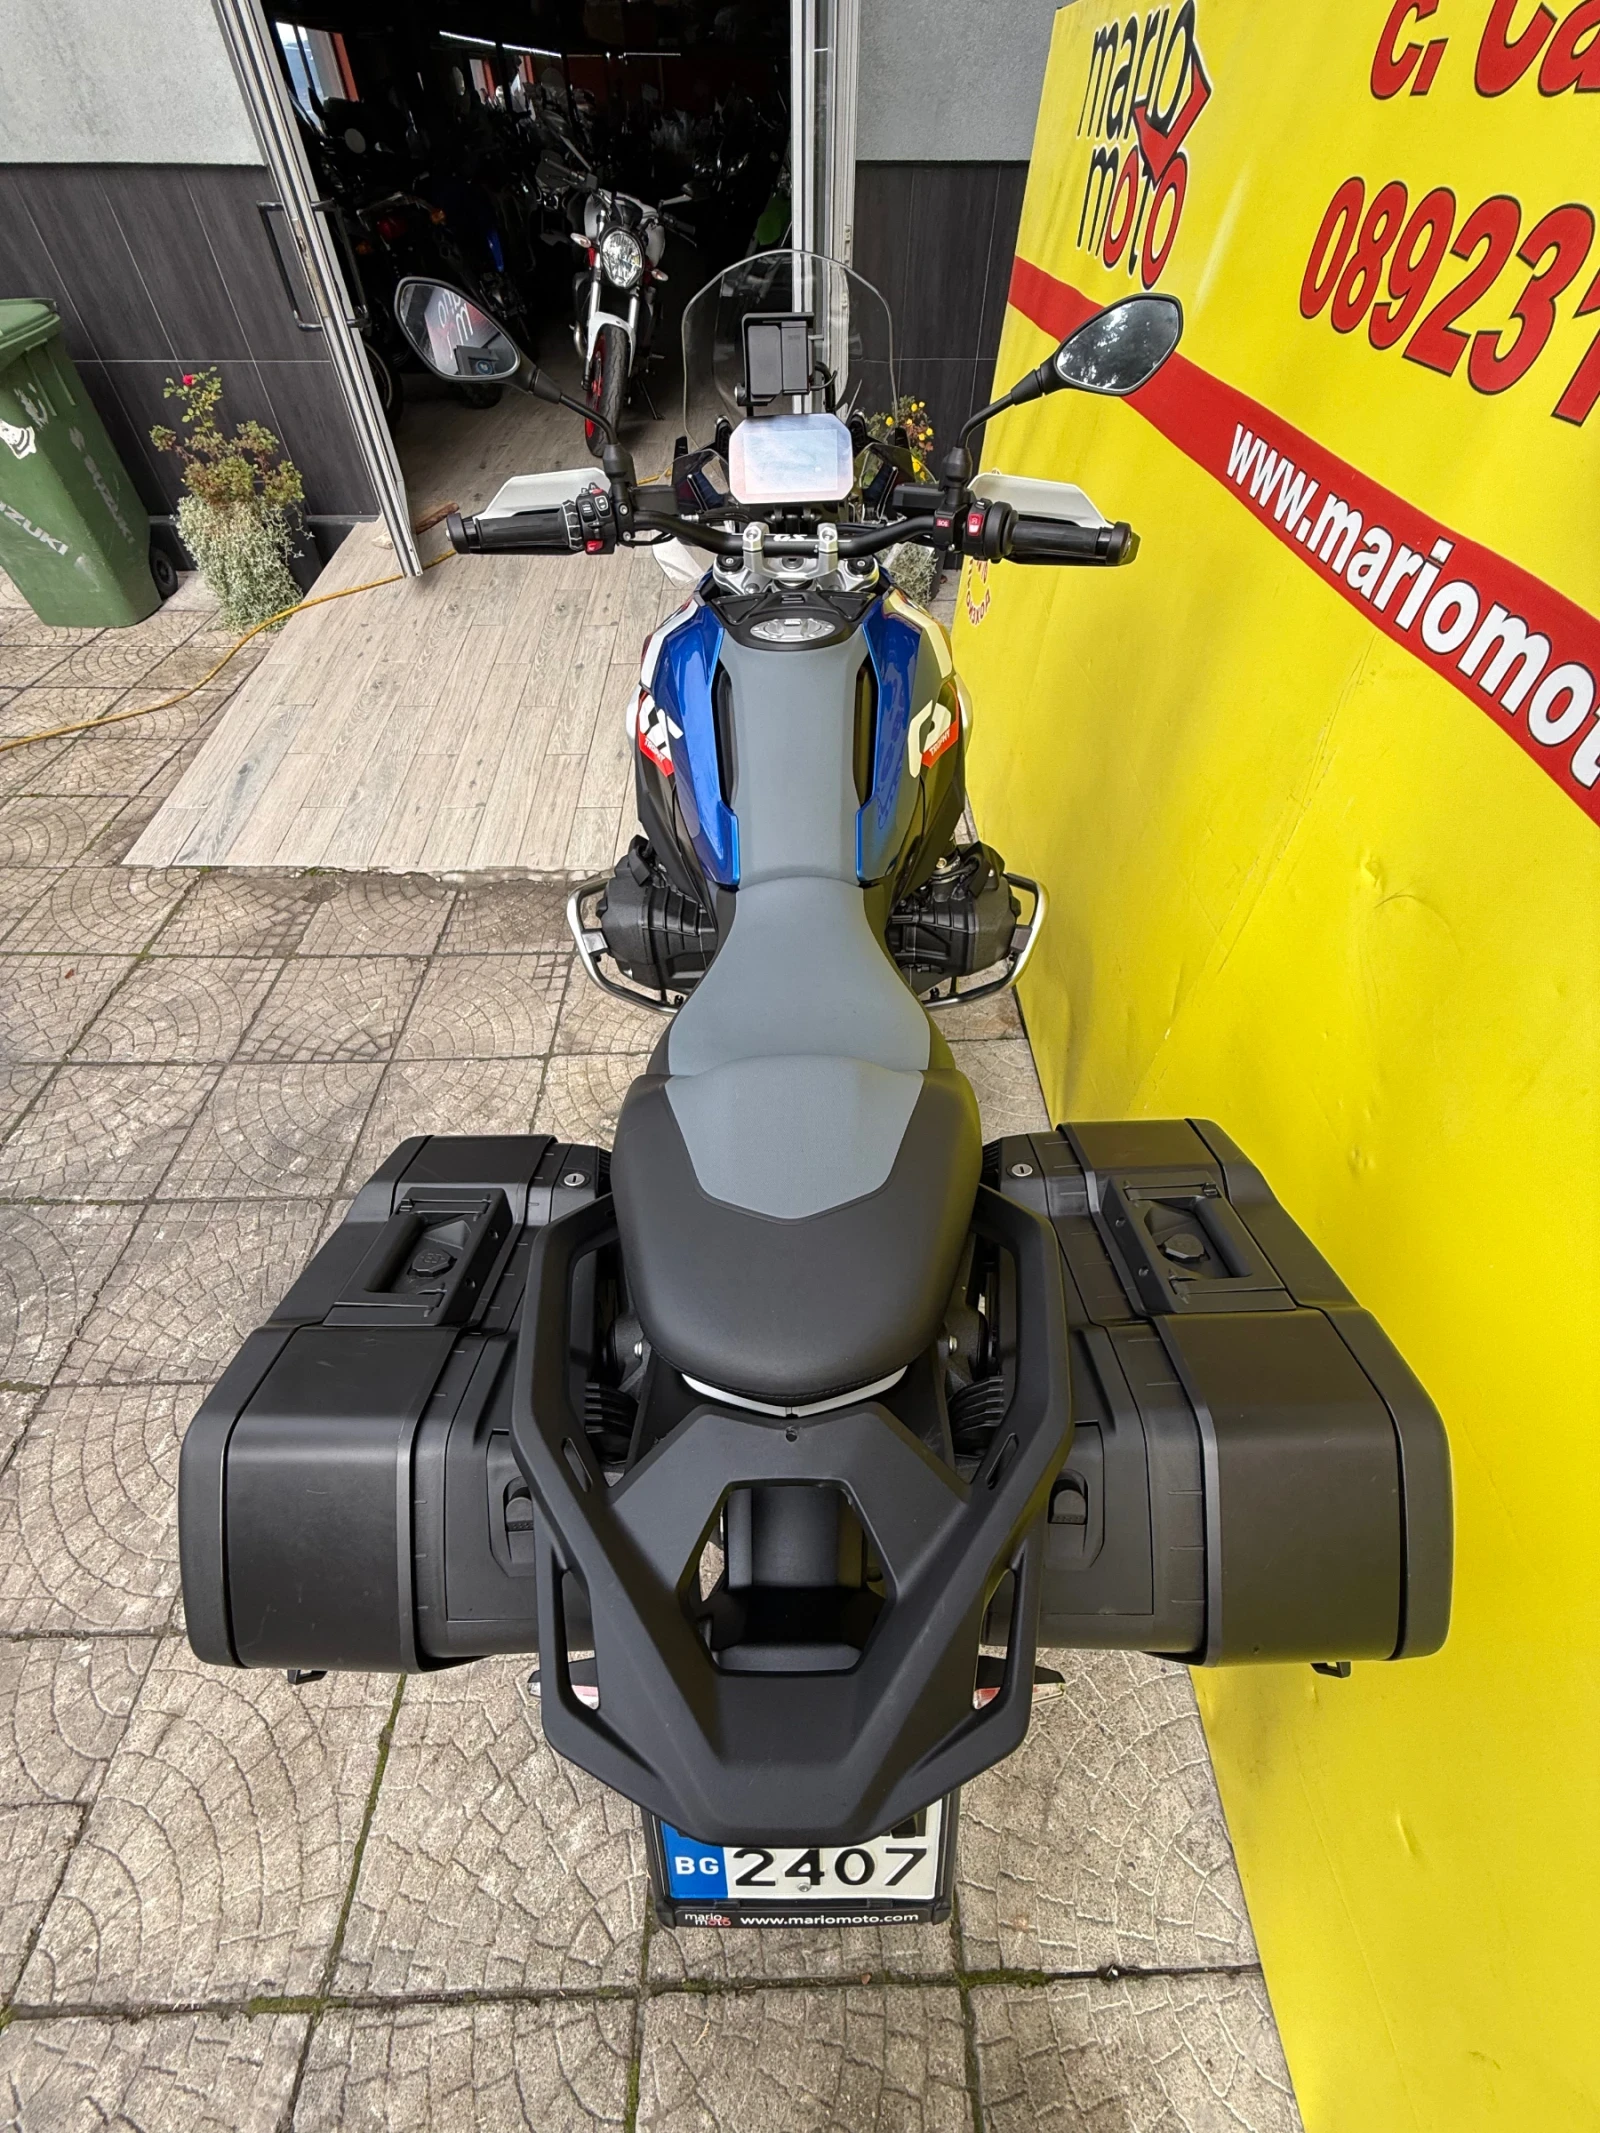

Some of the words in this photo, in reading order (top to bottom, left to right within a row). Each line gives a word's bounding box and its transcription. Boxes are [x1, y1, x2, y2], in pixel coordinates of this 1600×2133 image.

[1076, 0, 1196, 141] mario
[1076, 146, 1188, 291] moto
[675, 1855, 720, 1876] BG
[732, 1847, 928, 1887] 2407
[684, 1912, 723, 1922] mario
[740, 1914, 919, 1926] www.mariomoto.com
